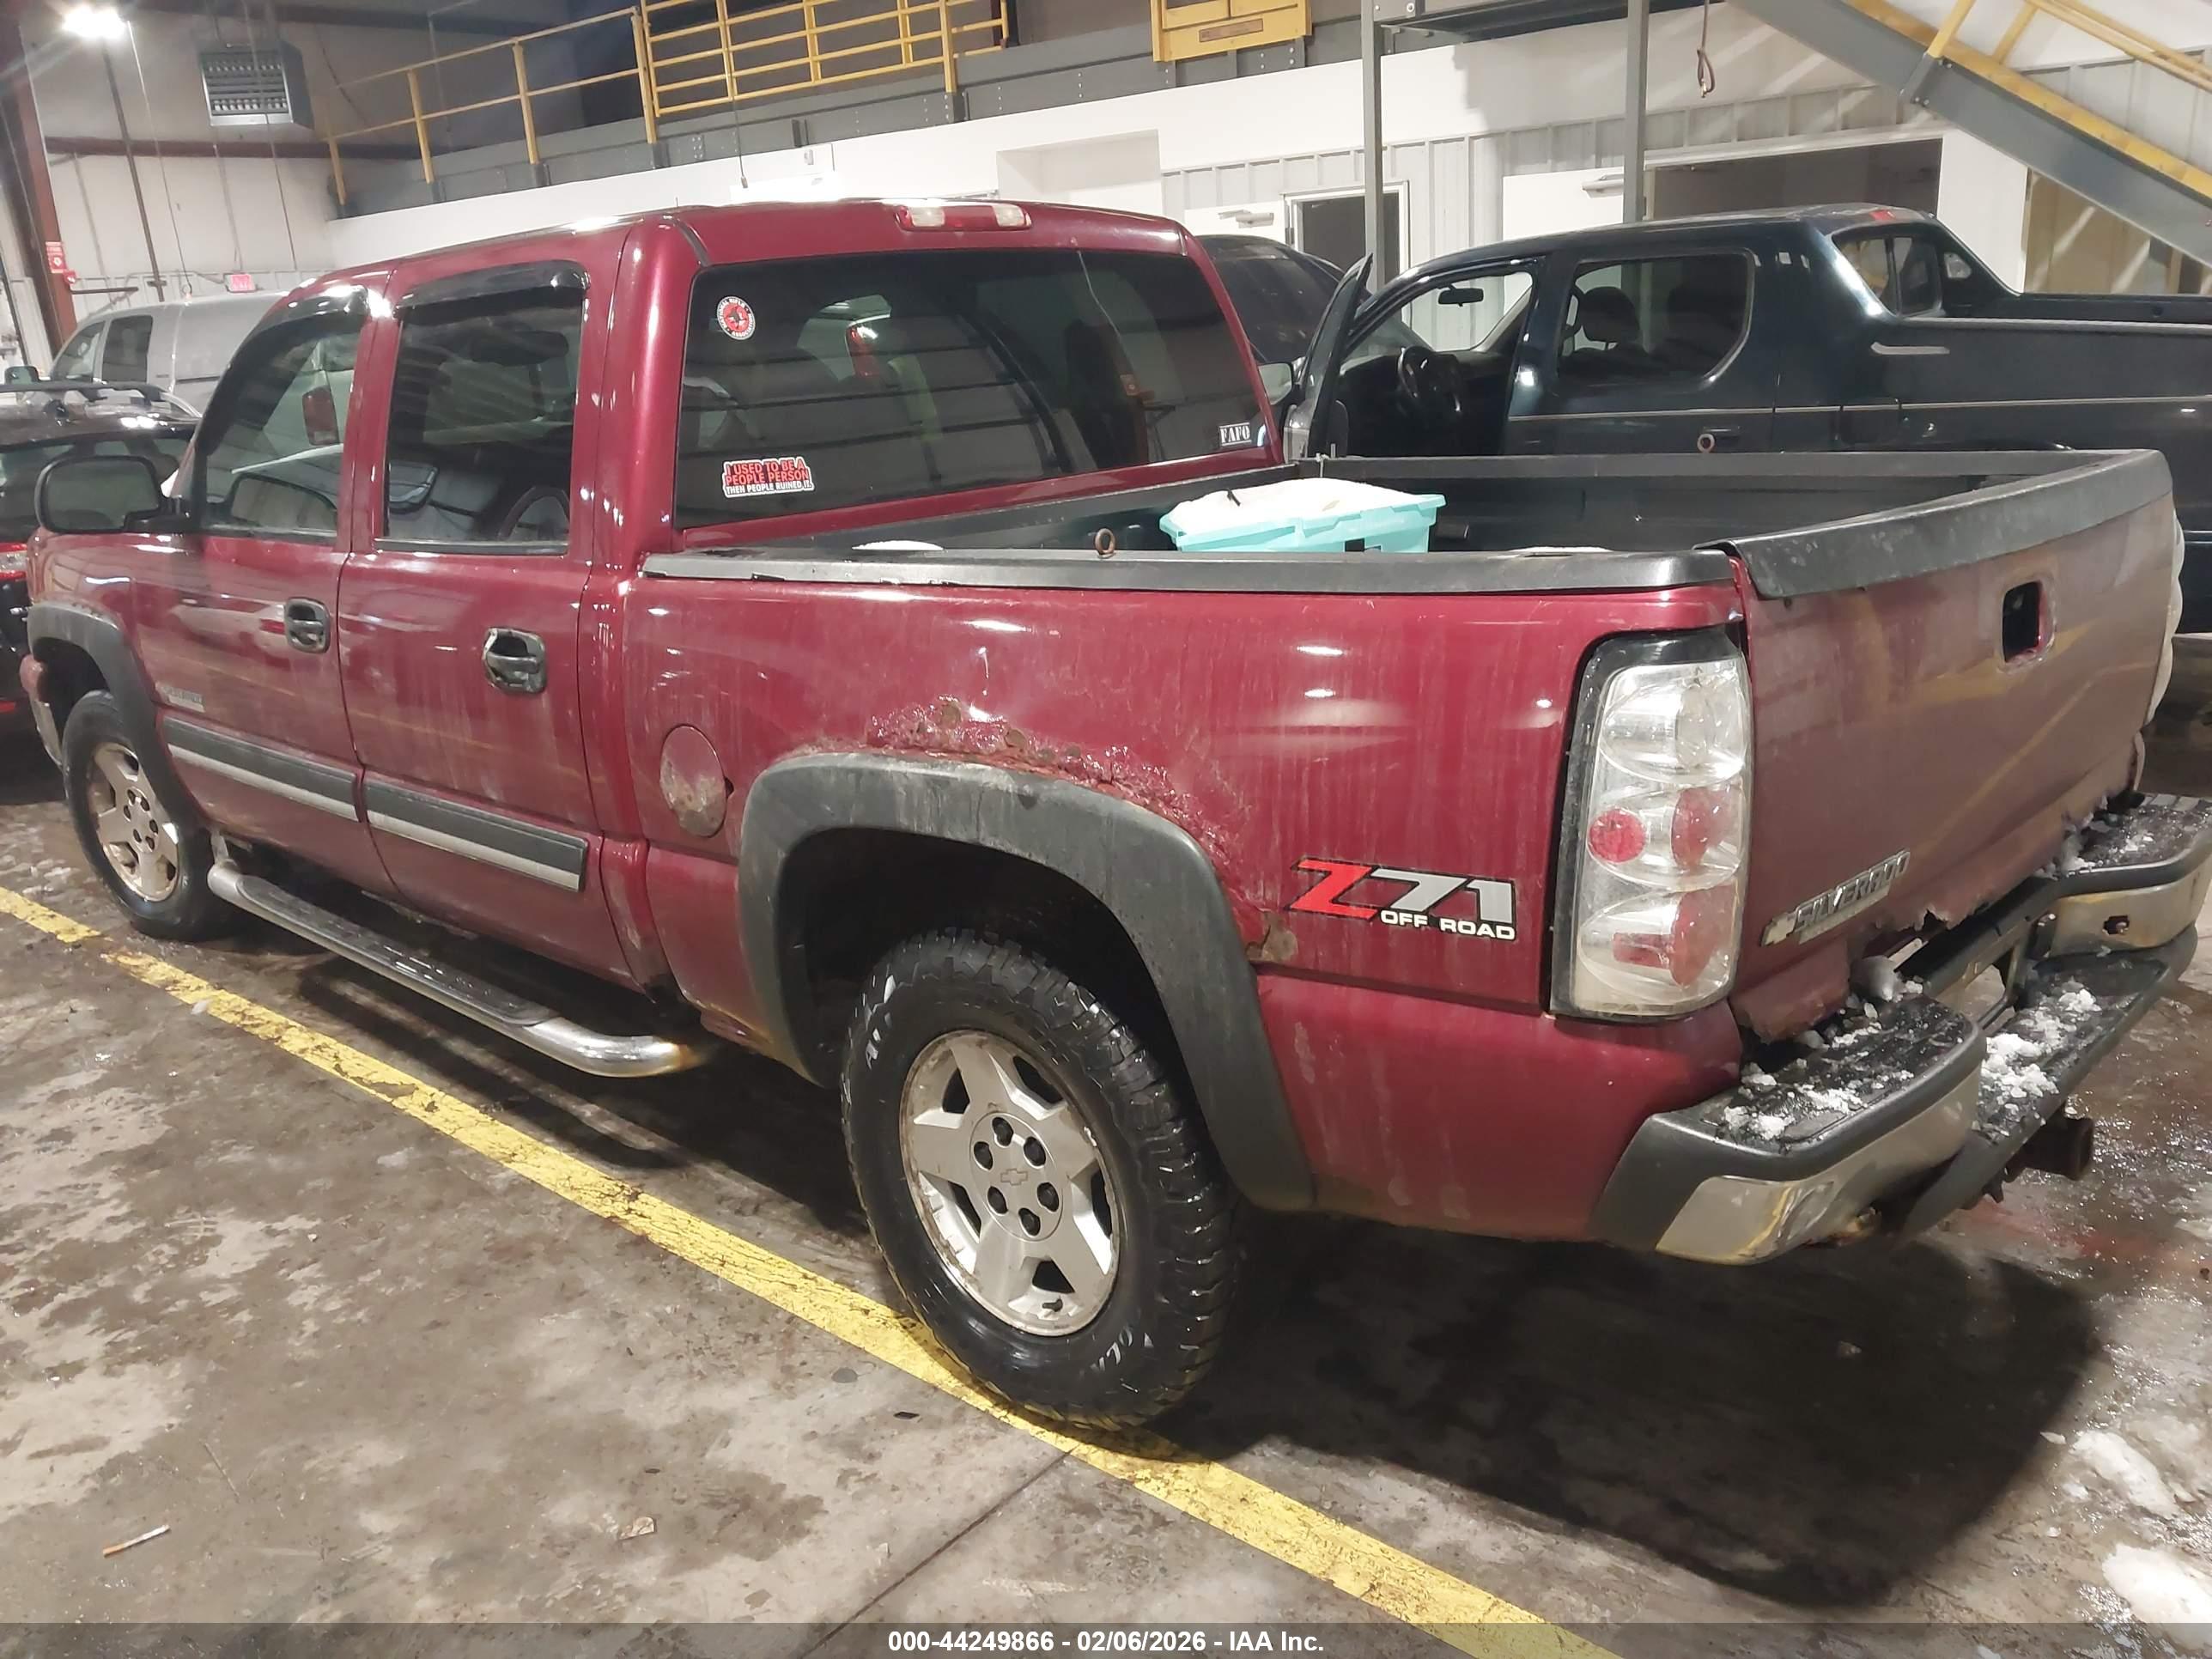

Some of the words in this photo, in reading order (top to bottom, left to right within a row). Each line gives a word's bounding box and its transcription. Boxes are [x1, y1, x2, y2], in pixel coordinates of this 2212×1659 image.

[1220, 425, 1250, 443] FAFO
[726, 464, 731, 475] I
[733, 463, 763, 474] USED
[765, 461, 779, 471] TO
[781, 459, 794, 471] BE
[797, 459, 805, 470] A
[725, 472, 766, 486] PEOPLE
[768, 469, 810, 482] PERSON
[726, 485, 746, 495] THEN
[746, 483, 774, 493] PEOPLE
[775, 480, 802, 490] RUINED
[1290, 859, 1513, 924] Z71
[1380, 910, 1428, 928] OFF
[1439, 917, 1516, 941] ROAD
